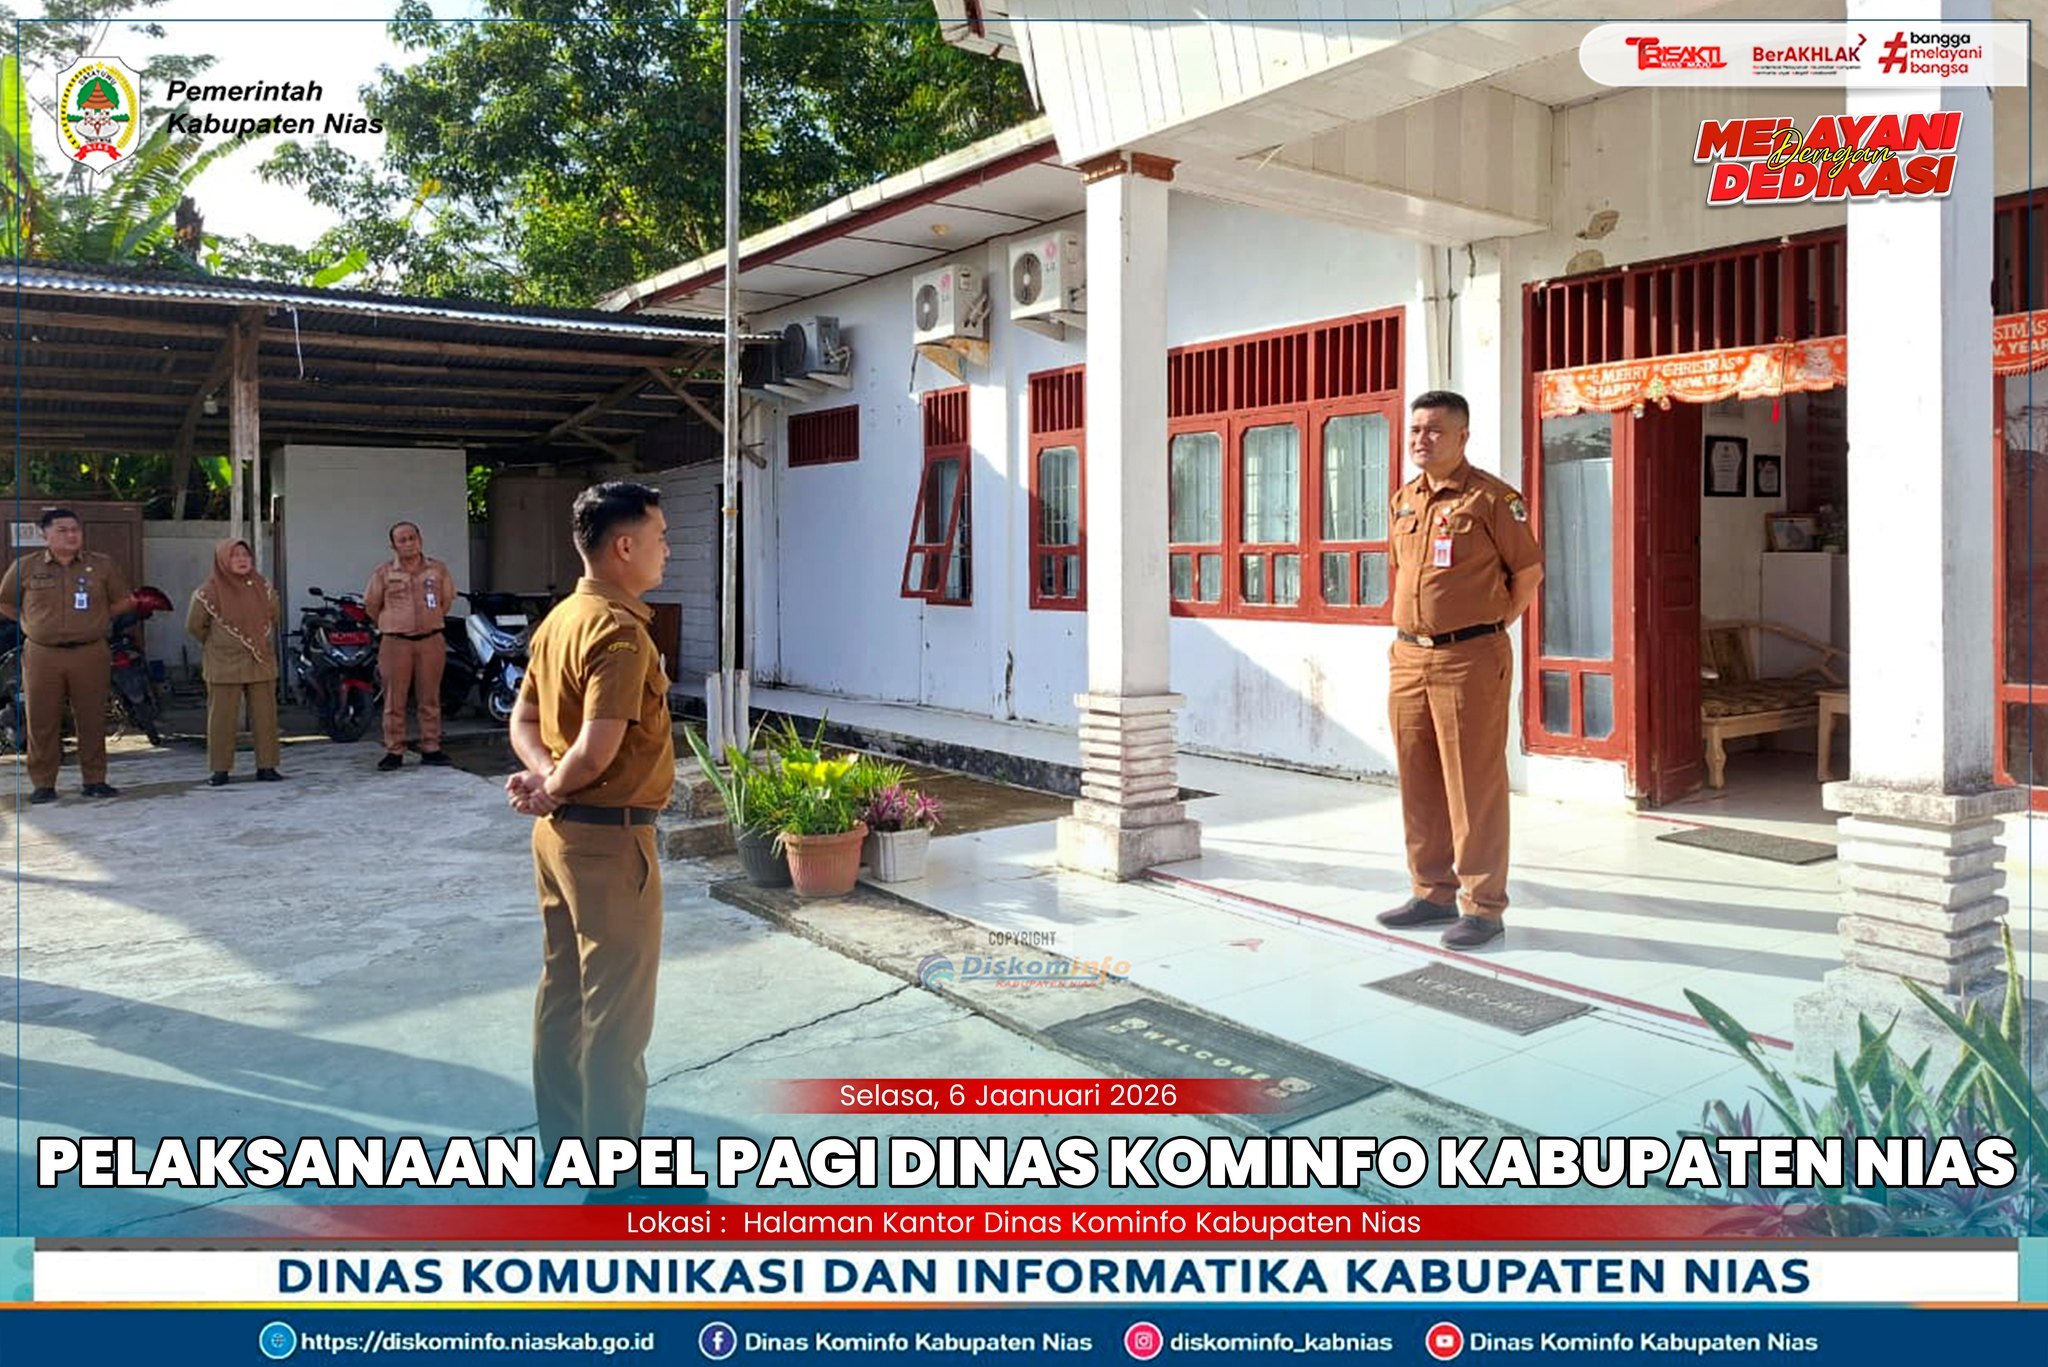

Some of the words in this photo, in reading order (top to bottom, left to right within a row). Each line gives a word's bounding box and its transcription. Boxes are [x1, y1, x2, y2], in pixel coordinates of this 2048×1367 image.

[1601, 365, 1649, 384] MERRY
[1663, 357, 1735, 377] CHRISTMAS
[1590, 382, 1641, 398] HAPPY
